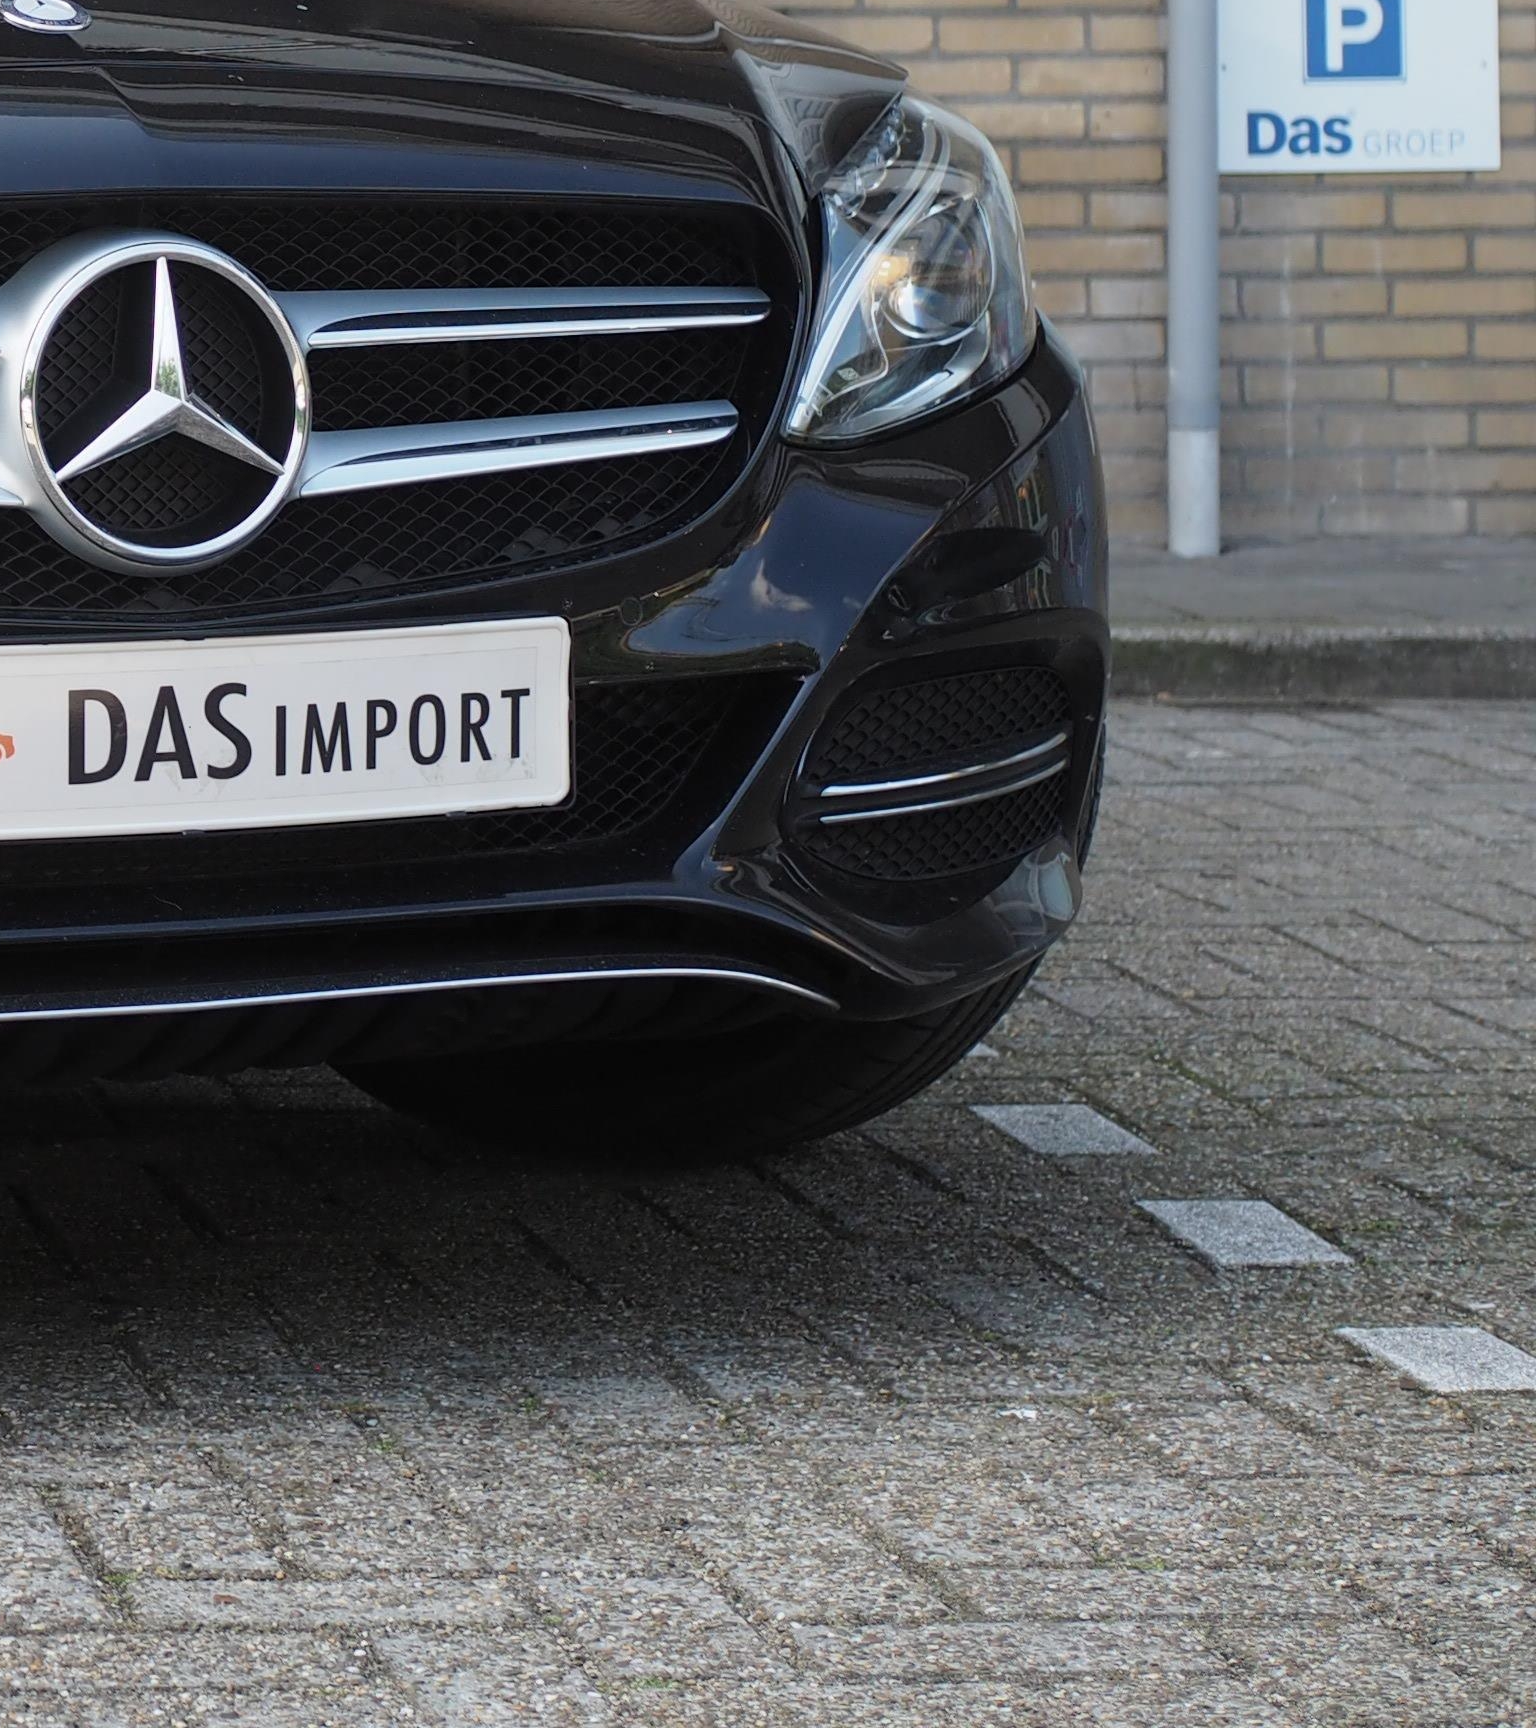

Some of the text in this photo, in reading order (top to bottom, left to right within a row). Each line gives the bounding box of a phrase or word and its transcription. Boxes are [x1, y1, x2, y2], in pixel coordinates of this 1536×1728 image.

[1246, 111, 1466, 159] Das GROEP
[67, 682, 532, 786] DAS IMPORT
